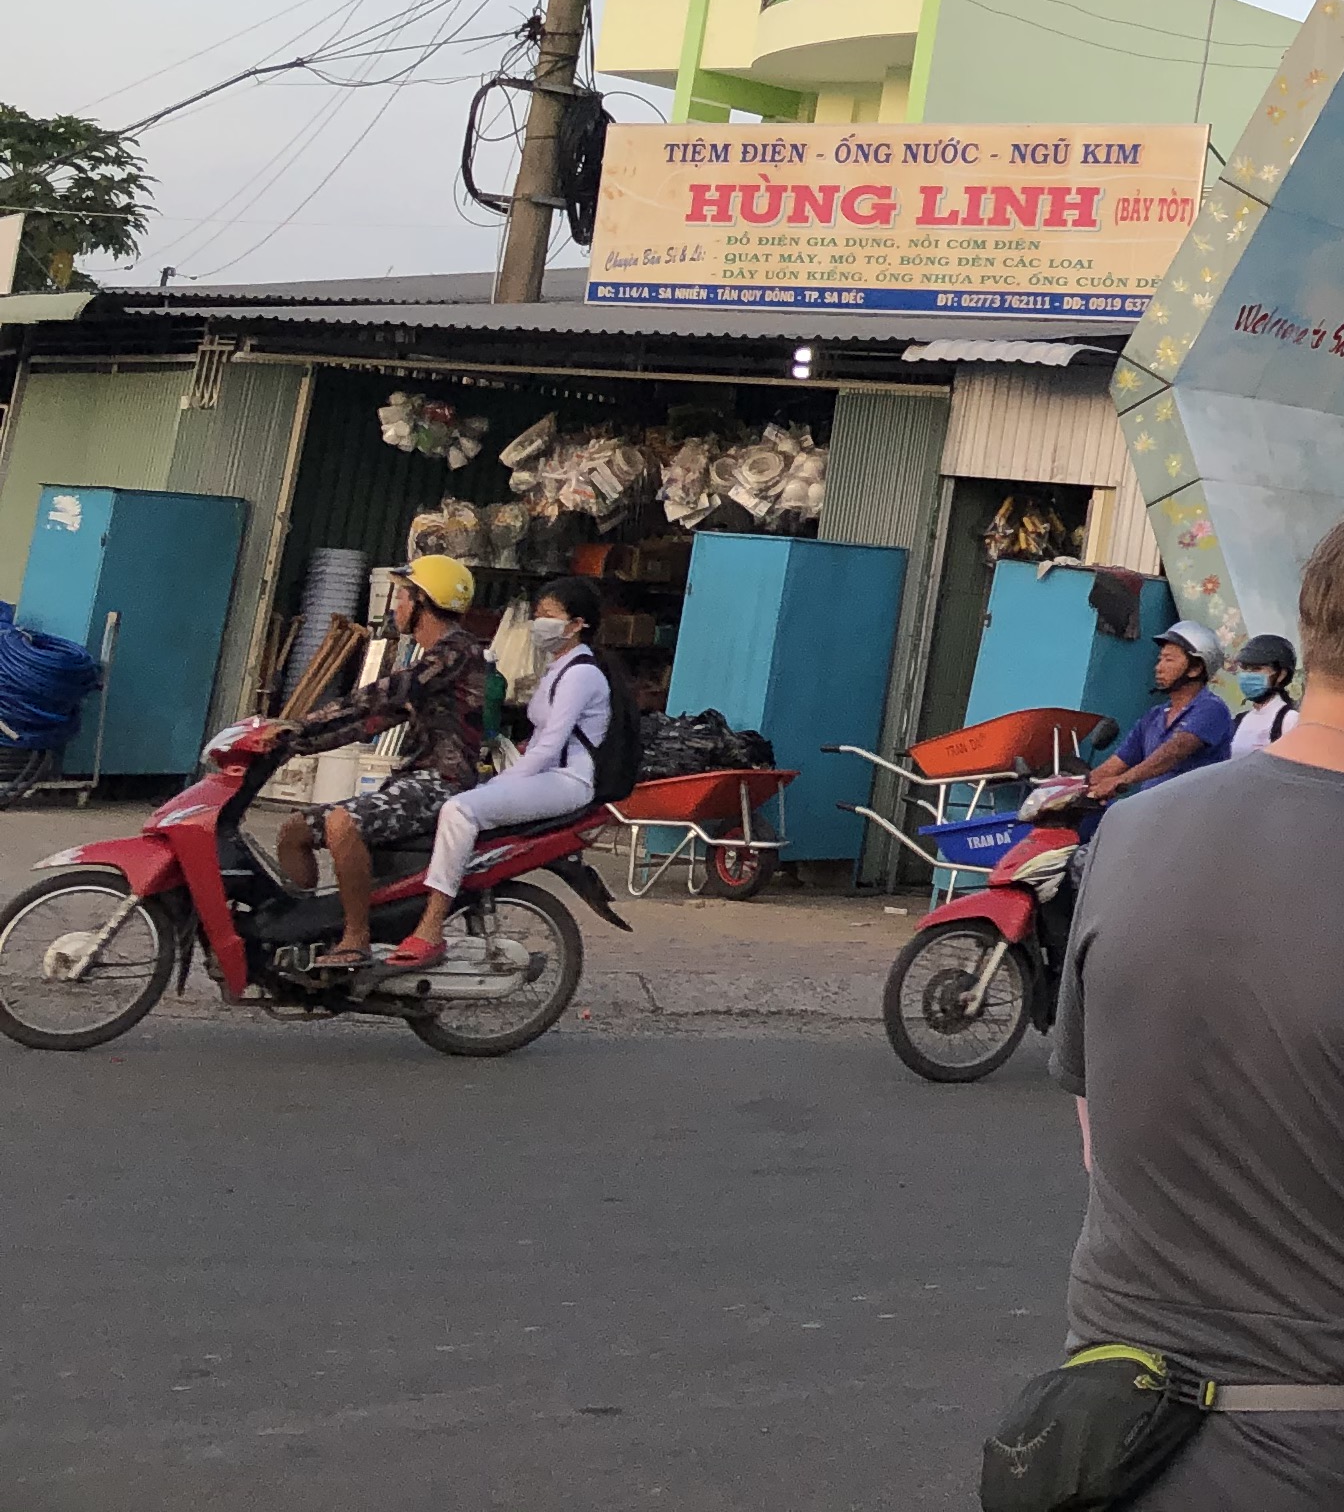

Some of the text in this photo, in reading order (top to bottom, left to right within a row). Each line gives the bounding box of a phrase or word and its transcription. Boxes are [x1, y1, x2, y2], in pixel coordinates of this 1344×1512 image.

[664, 138, 731, 168] TIỆM
[740, 138, 808, 168] ĐIỆN
[834, 133, 893, 165] ỐNG
[901, 136, 980, 166] NƯỚC
[1009, 138, 1071, 166] NGŨ
[1080, 143, 1142, 166] KIM
[685, 173, 1102, 229] HÙNG LINH
[1115, 188, 1154, 226] (BẢY
[757, 235, 801, 247] ĐIỆN
[807, 237, 838, 248] GIA
[1049, 258, 1094, 271] LOẠI
[920, 272, 973, 287] NHỰA
[1028, 270, 1069, 287] ỐNG
[617, 286, 649, 299] 114/A
[658, 287, 672, 300] SA
[741, 289, 762, 302] QUY
[824, 291, 839, 304] SA
[841, 289, 865, 304] ĐÉC
[961, 293, 1000, 308] 02773
[1003, 294, 1050, 309] 762111
[1088, 296, 1122, 311] 0919
[967, 834, 994, 849] TRAN
